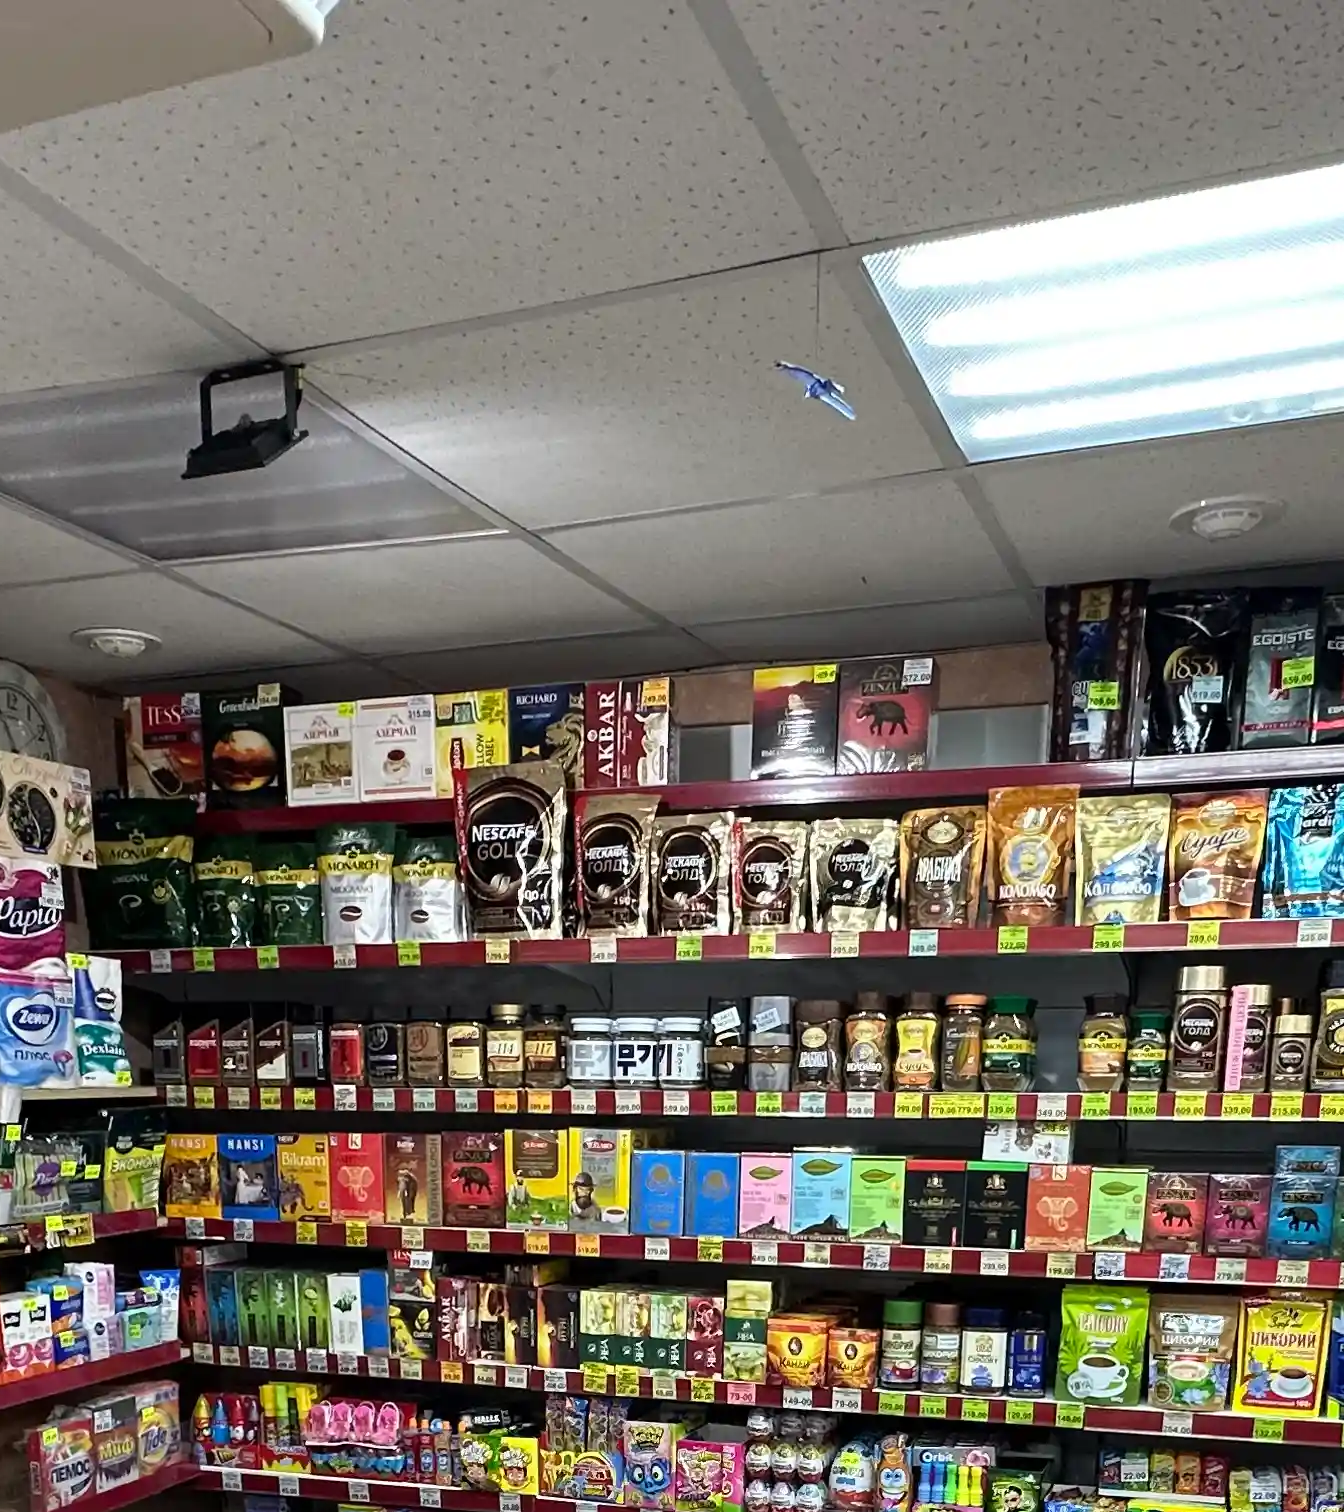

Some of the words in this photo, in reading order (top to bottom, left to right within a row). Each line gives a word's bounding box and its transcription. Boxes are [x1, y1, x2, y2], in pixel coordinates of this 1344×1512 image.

[1251, 628, 1315, 647] EGOISTE
[598, 690, 617, 777] AKBAR
[19, 1007, 51, 1026] Zewa
[227, 1138, 265, 1151] NANSI
[281, 1151, 327, 1167] Bikram
[1250, 1332, 1316, 1348] ЦИКОРИЙ
[922, 1450, 954, 1463] Orbit
